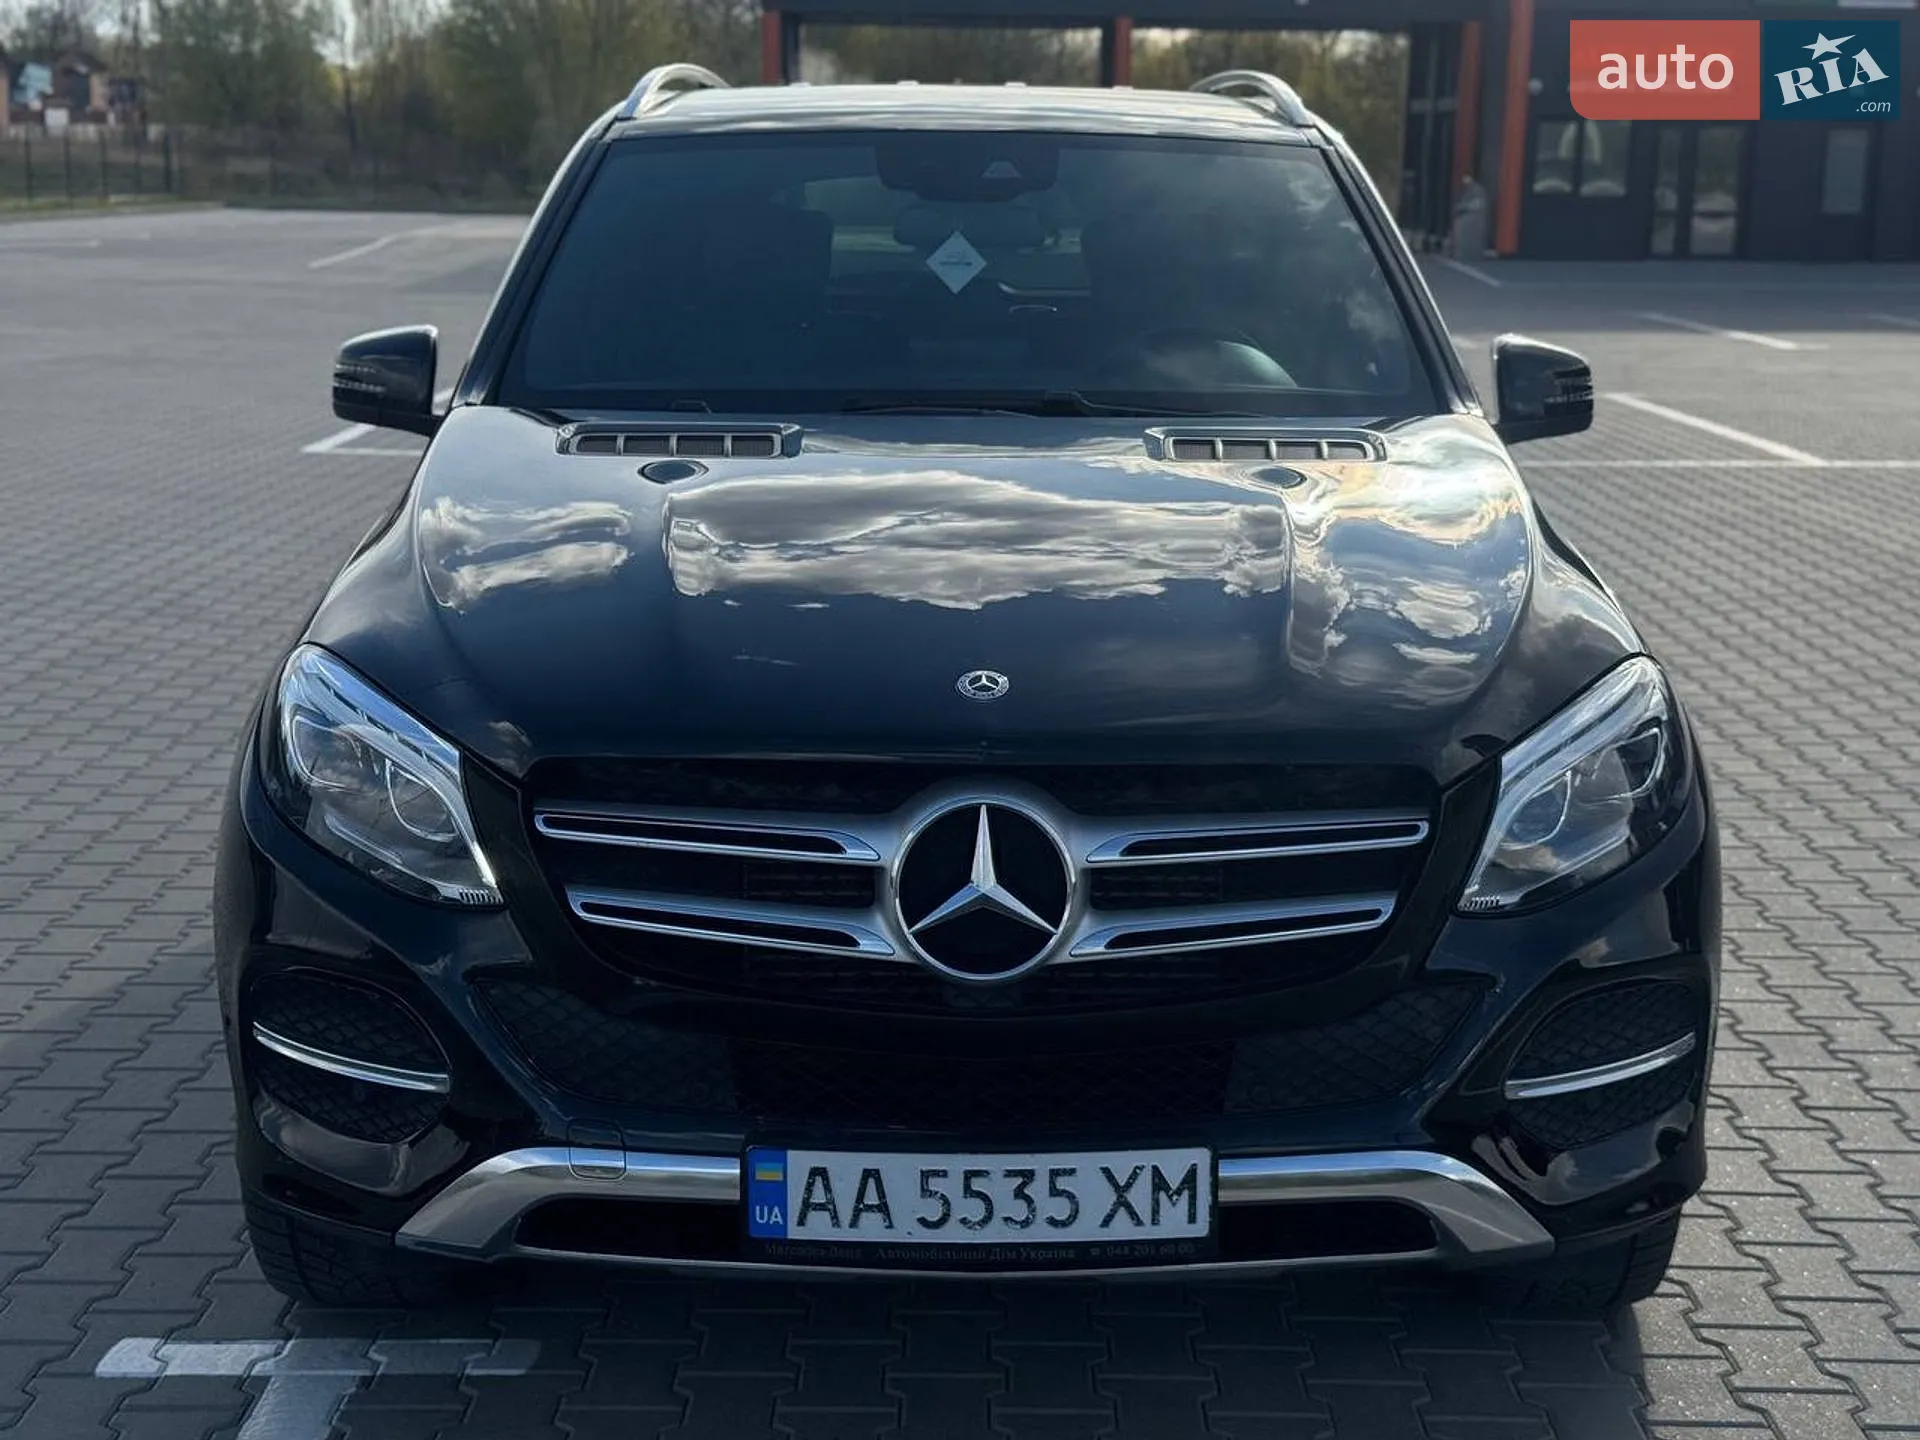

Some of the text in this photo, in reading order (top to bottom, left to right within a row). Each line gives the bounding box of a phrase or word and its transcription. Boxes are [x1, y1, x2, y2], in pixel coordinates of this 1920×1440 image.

[755, 1205, 783, 1224] UA
[796, 1163, 1198, 1231] AA 5535 XM
